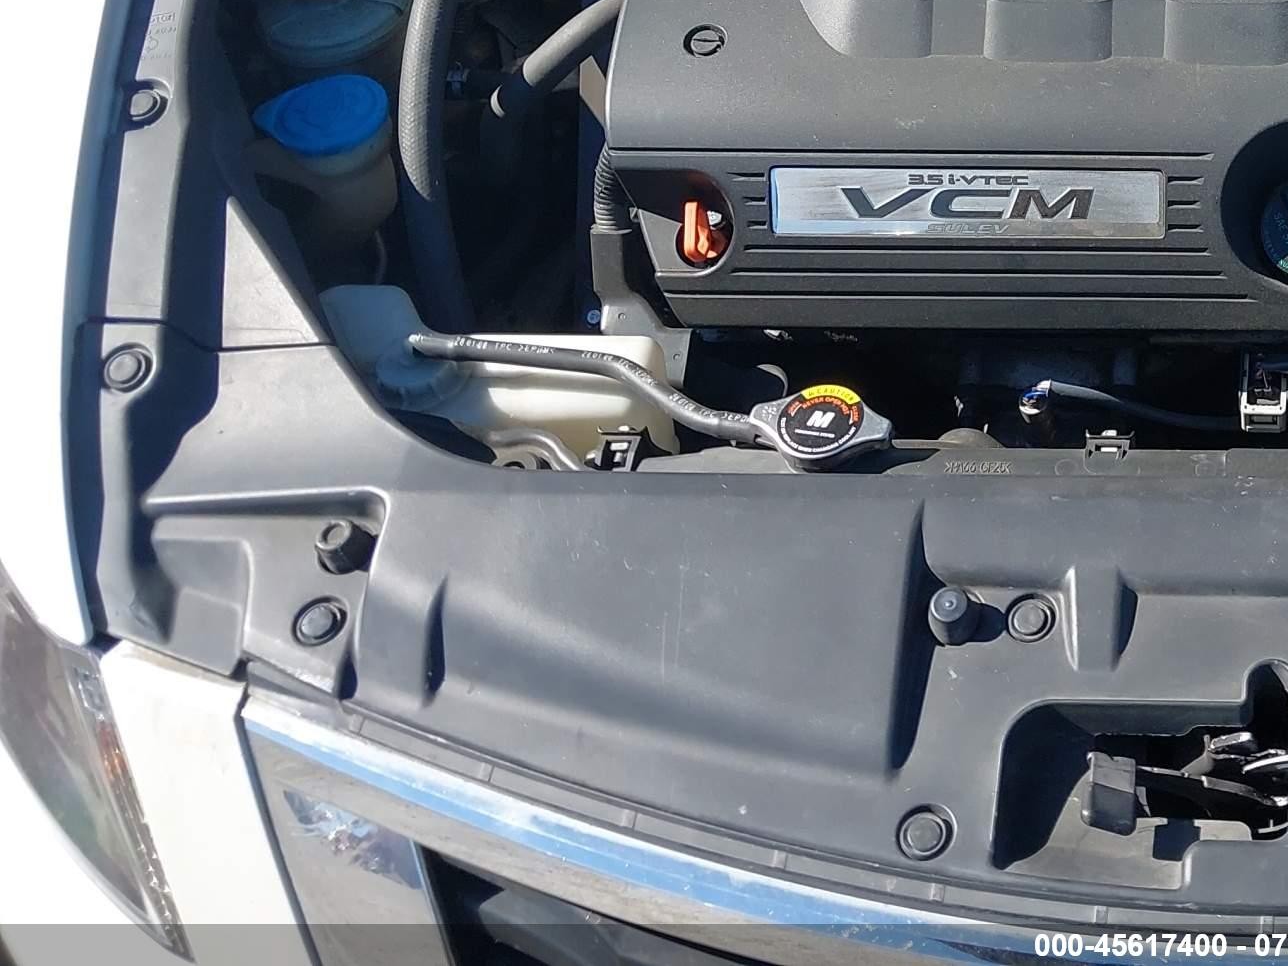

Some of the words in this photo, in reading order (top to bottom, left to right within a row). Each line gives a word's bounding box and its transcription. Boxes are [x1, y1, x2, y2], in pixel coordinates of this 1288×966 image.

[908, 174, 943, 184] 3.5
[948, 173, 1029, 185] i-VTEC
[840, 186, 1095, 220] VCM
[927, 223, 1009, 234] SULEV
[806, 410, 836, 428] M
